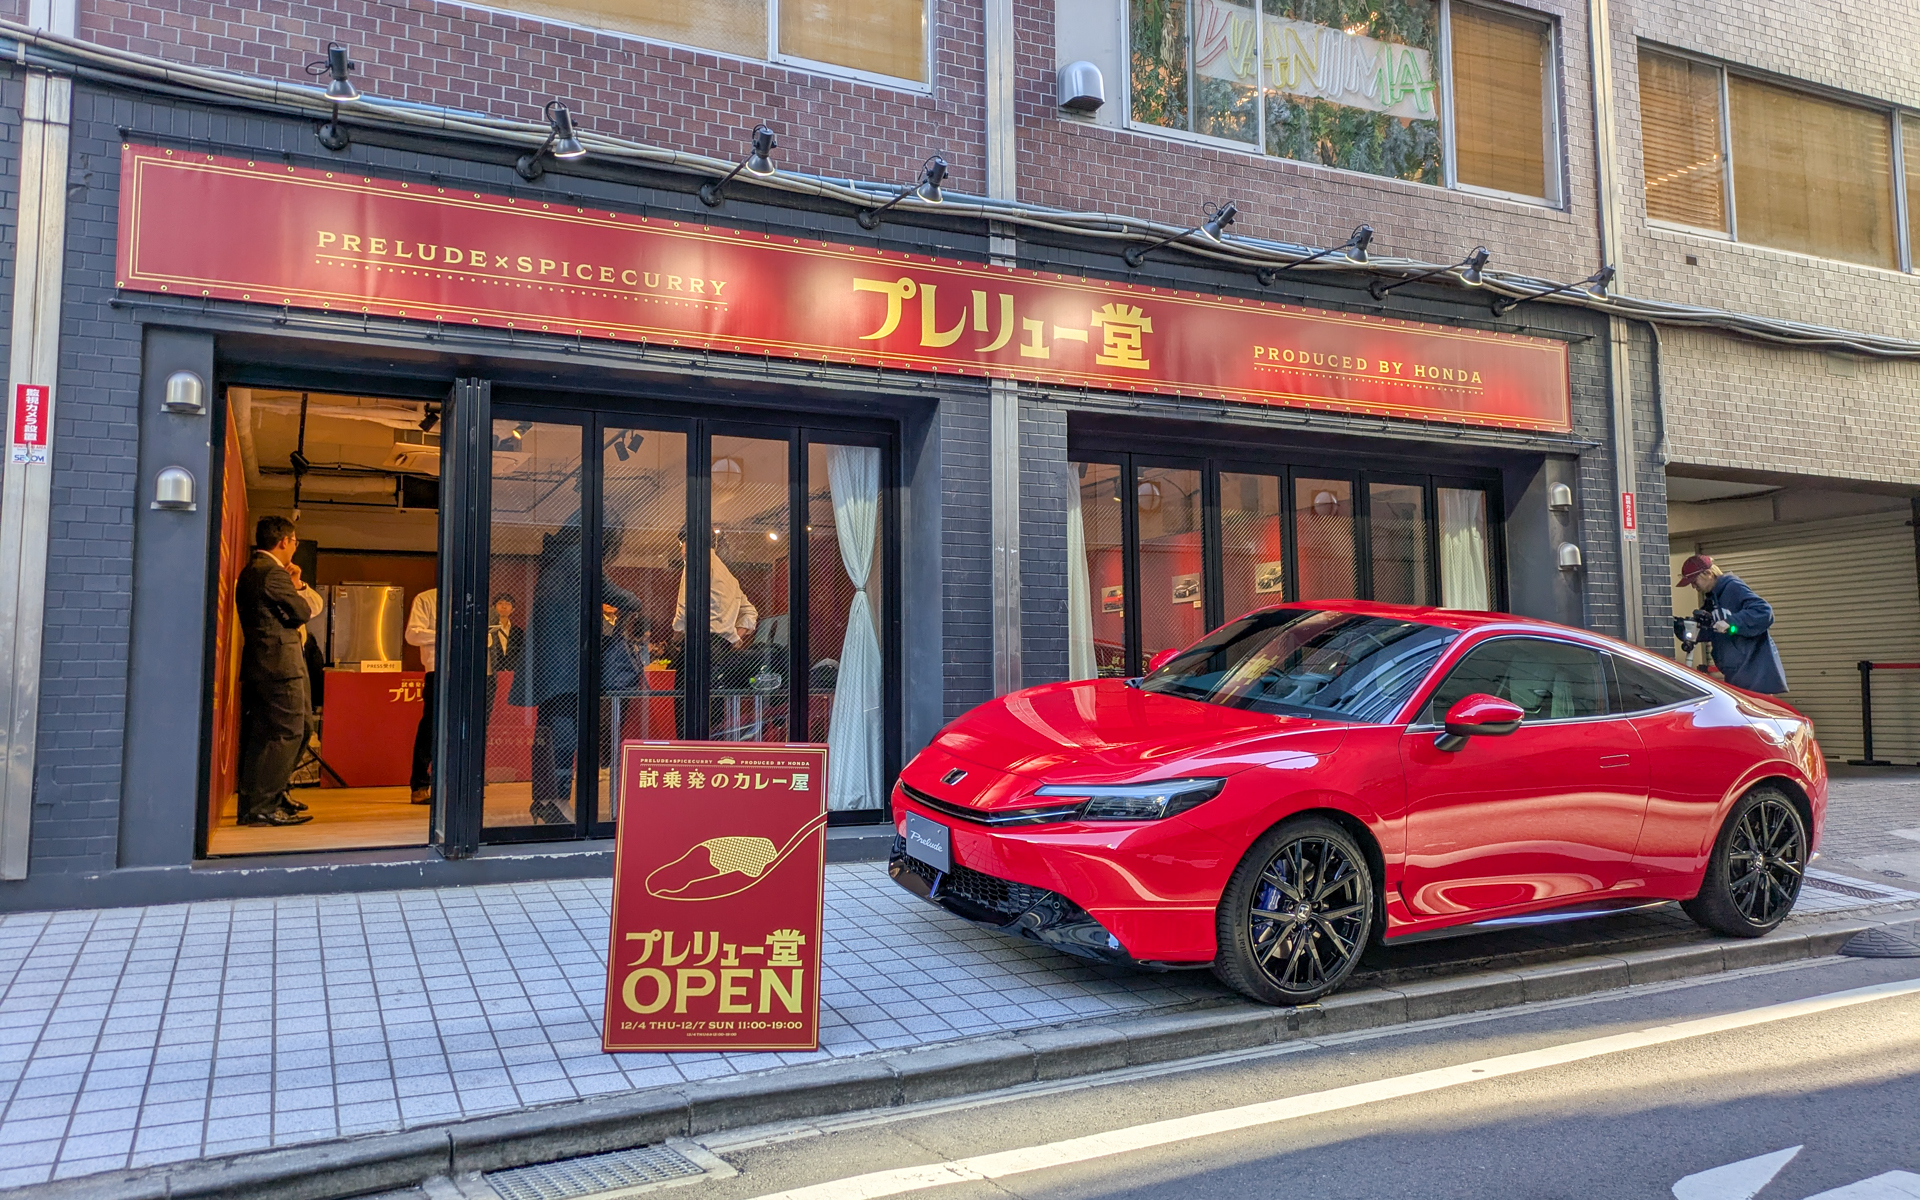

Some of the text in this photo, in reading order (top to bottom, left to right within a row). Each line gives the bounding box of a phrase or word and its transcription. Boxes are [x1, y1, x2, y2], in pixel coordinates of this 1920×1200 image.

[853, 277, 1154, 370] プレリュー堂
[1253, 345, 1482, 384] PRODUCED BY HONDA
[24, 388, 40, 441] 監視カメラ設置
[14, 454, 44, 462] SEOM
[639, 769, 810, 791] 試乗発のカレー屋
[911, 830, 943, 853] Prelude
[625, 929, 806, 967] プレリュー堂
[622, 967, 804, 1015] OPEN
[621, 1021, 803, 1030] 12/4 THU-12/7 SUN 11:00-19:00
